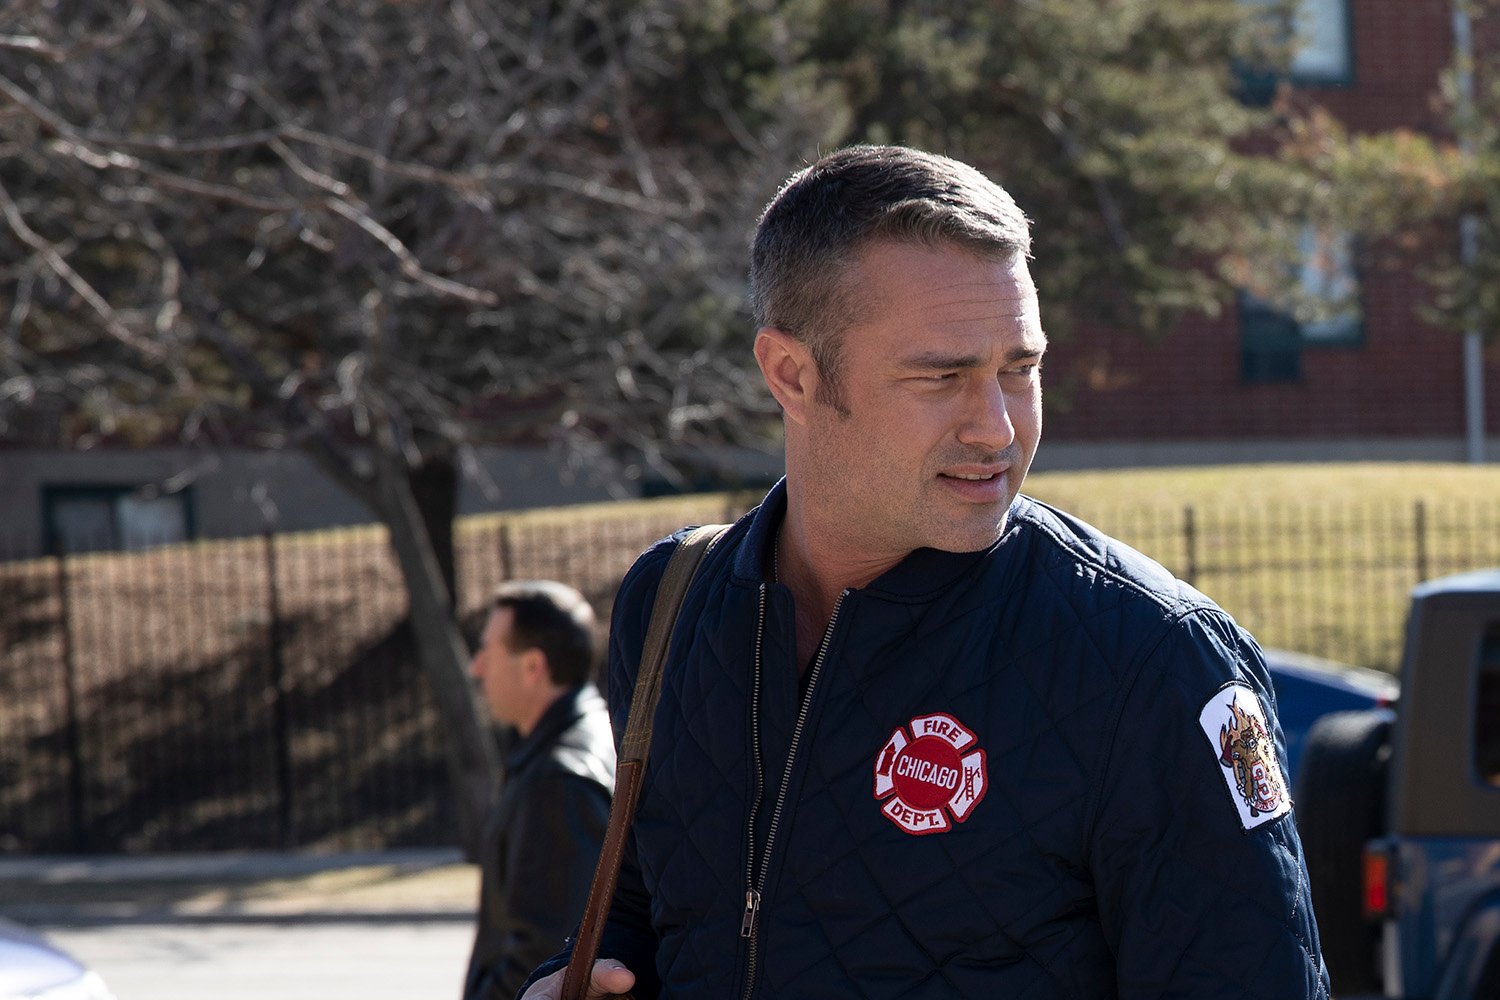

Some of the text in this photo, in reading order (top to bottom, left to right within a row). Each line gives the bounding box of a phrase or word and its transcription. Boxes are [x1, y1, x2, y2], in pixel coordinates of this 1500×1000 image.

[923, 720, 962, 743] FIRE
[896, 755, 958, 790] CHICAGO
[890, 801, 940, 826] DEPT.
